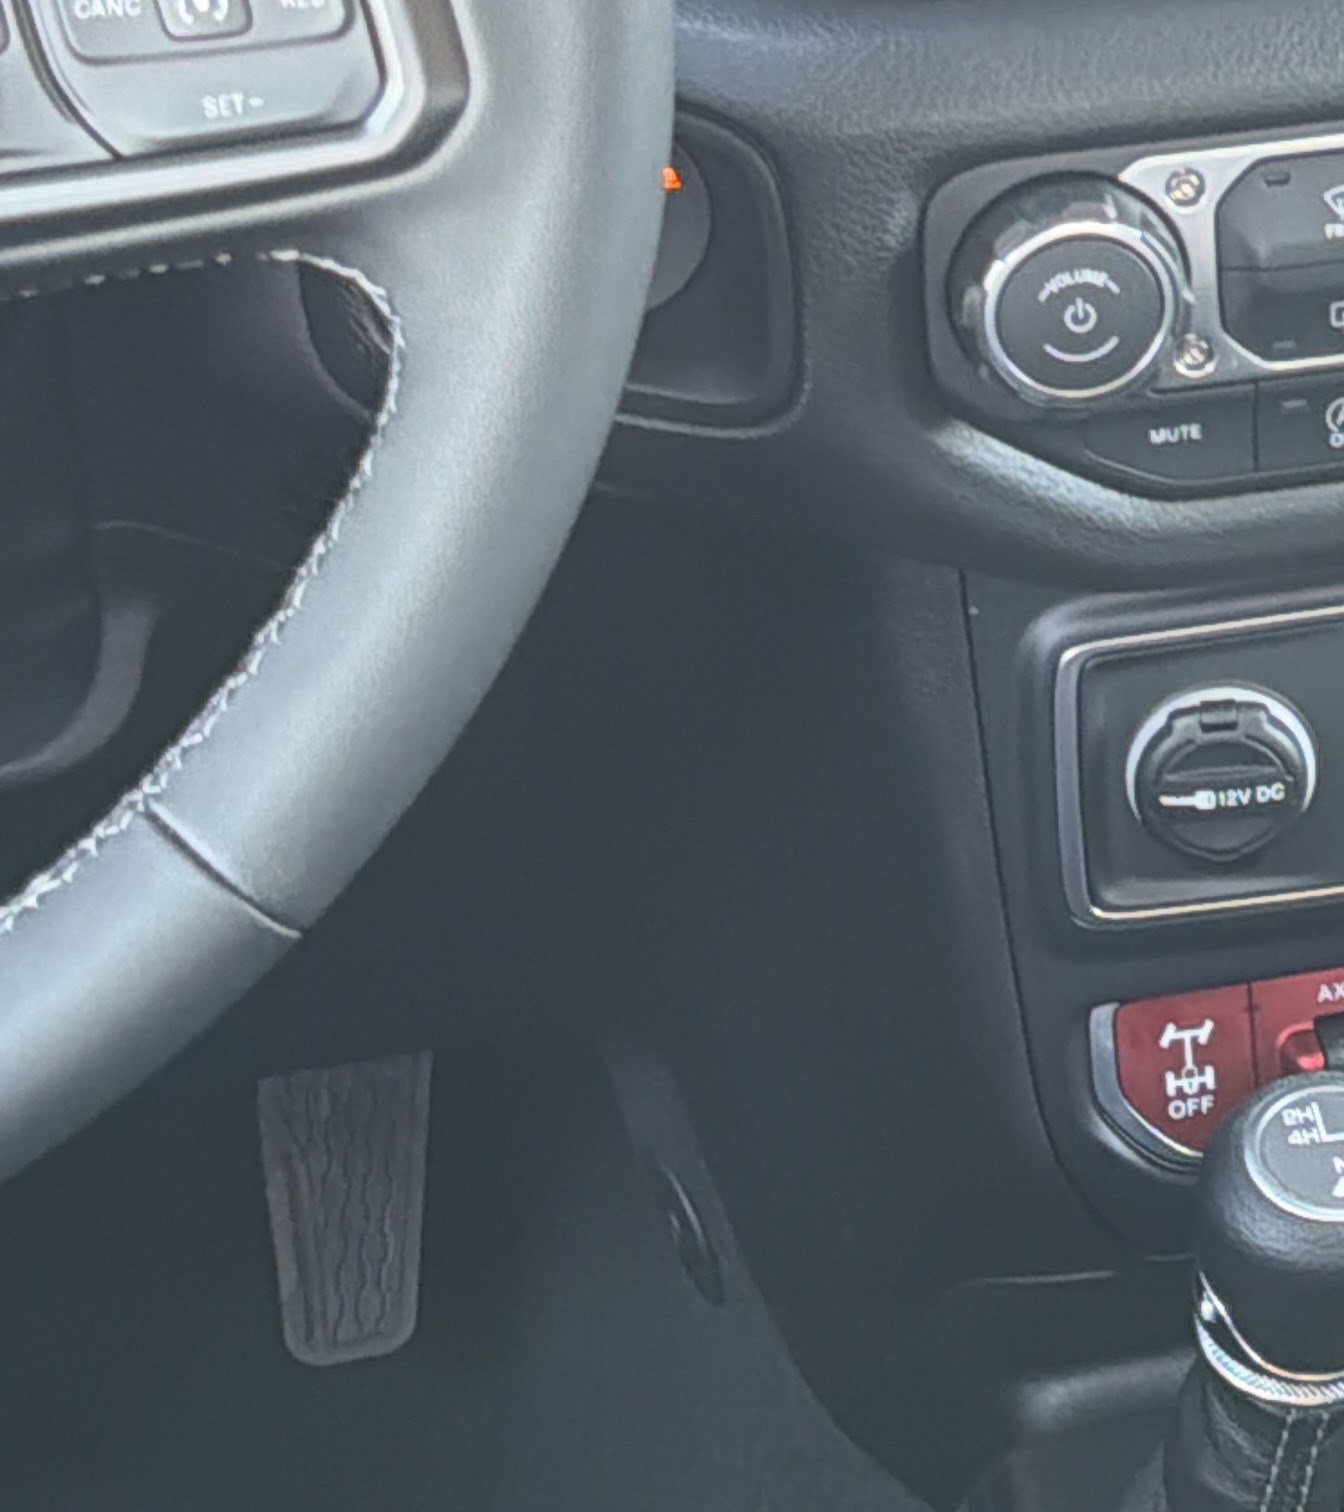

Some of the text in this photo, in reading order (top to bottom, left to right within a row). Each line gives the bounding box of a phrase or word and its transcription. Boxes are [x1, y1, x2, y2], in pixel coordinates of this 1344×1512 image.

[1044, 268, 1109, 293] VOLUME
[1149, 422, 1203, 445] MUTE
[1217, 782, 1286, 807] 12V DC
[1167, 1094, 1215, 1120] OFF
